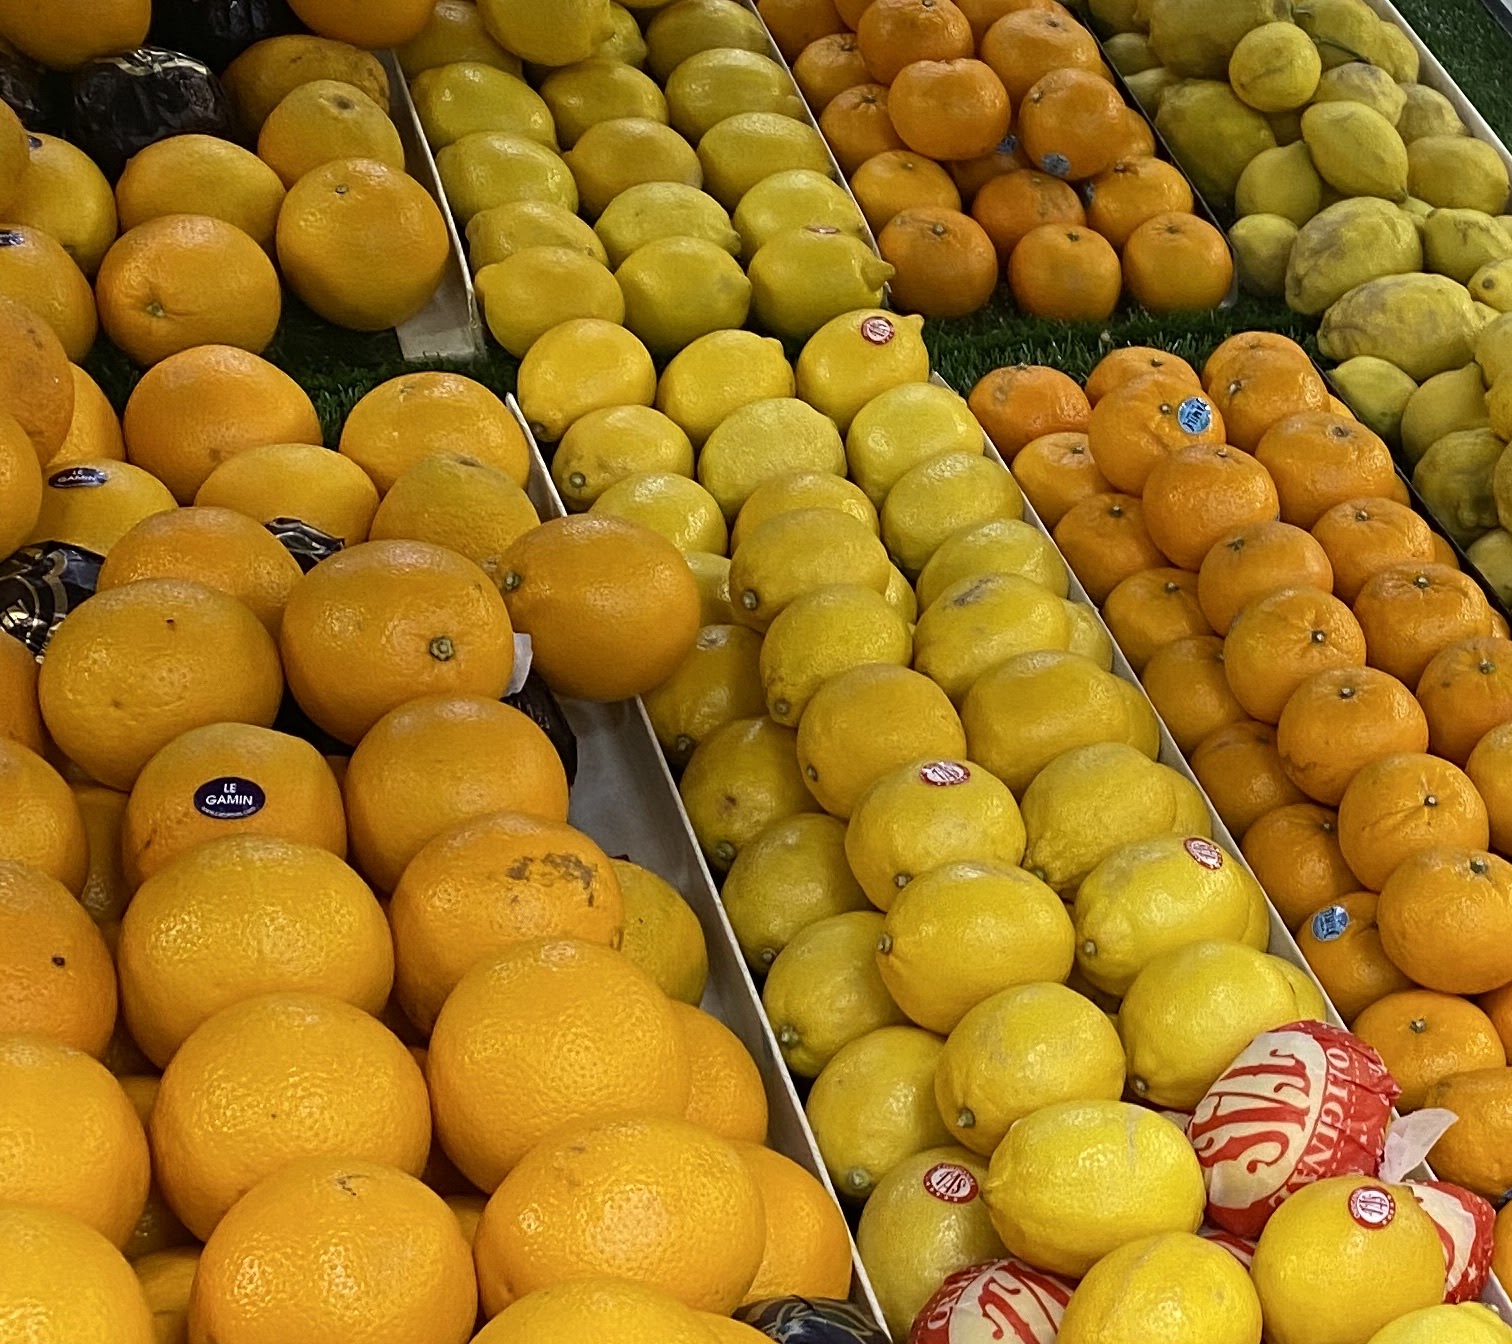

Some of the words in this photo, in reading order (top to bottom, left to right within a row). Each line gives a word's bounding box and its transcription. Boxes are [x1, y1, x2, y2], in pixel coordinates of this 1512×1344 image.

[223, 783, 237, 794] LE
[205, 794, 253, 806] GAMIN
[935, 1171, 967, 1194] TAS
